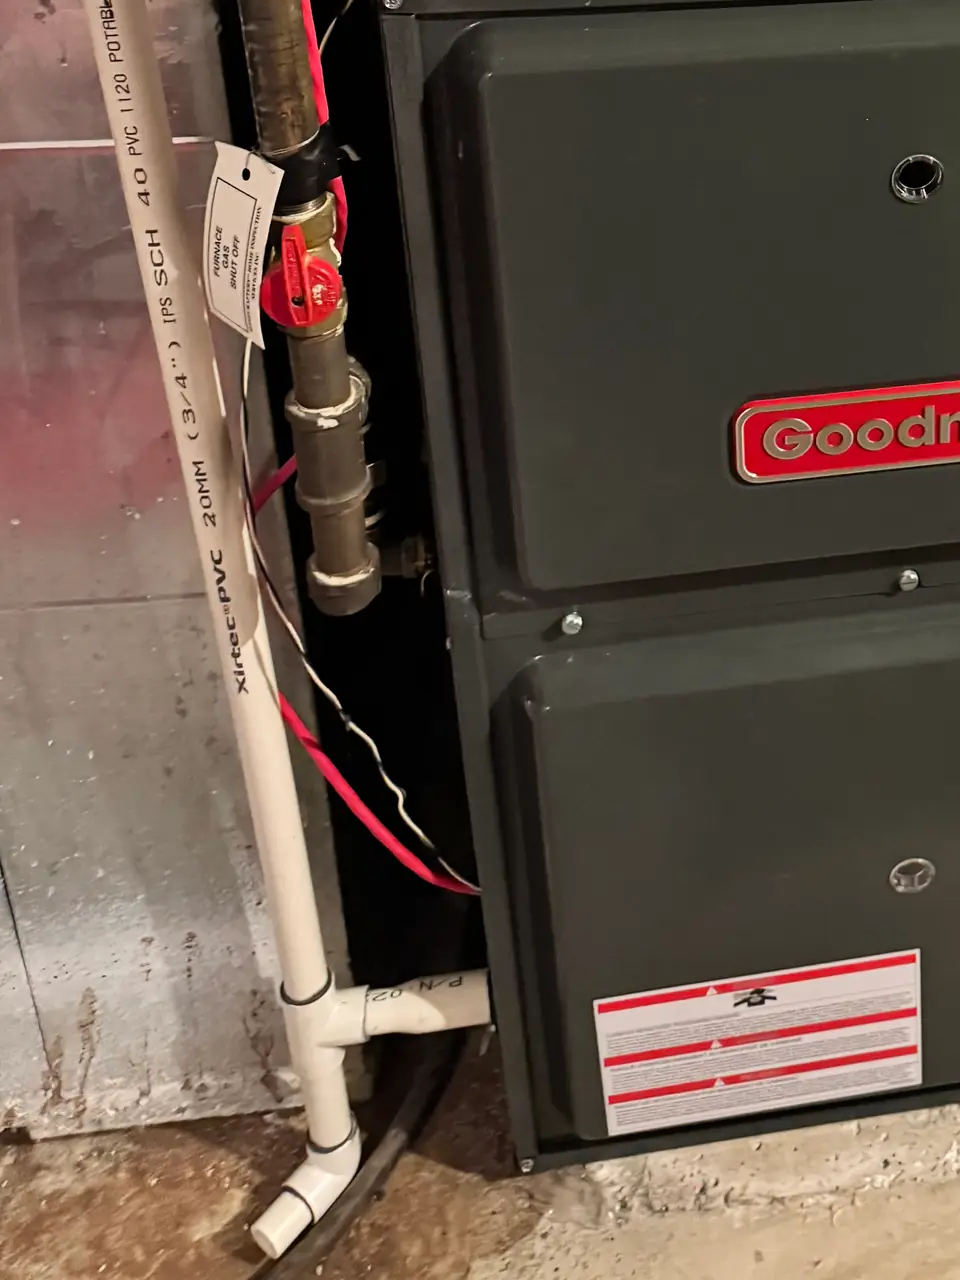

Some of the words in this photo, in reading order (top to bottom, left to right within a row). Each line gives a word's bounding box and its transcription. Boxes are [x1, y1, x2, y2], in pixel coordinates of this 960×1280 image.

[113, 73, 135, 112] 1120
[124, 125, 142, 156] PVC
[133, 168, 150, 206] 40
[145, 229, 169, 286] SCH
[214, 226, 223, 277] FURNACE
[221, 245, 230, 269] GAS
[232, 235, 240, 258] OFF
[230, 261, 238, 290] SHUT
[160, 297, 178, 324] IPS
[192, 460, 216, 527] 20MM
